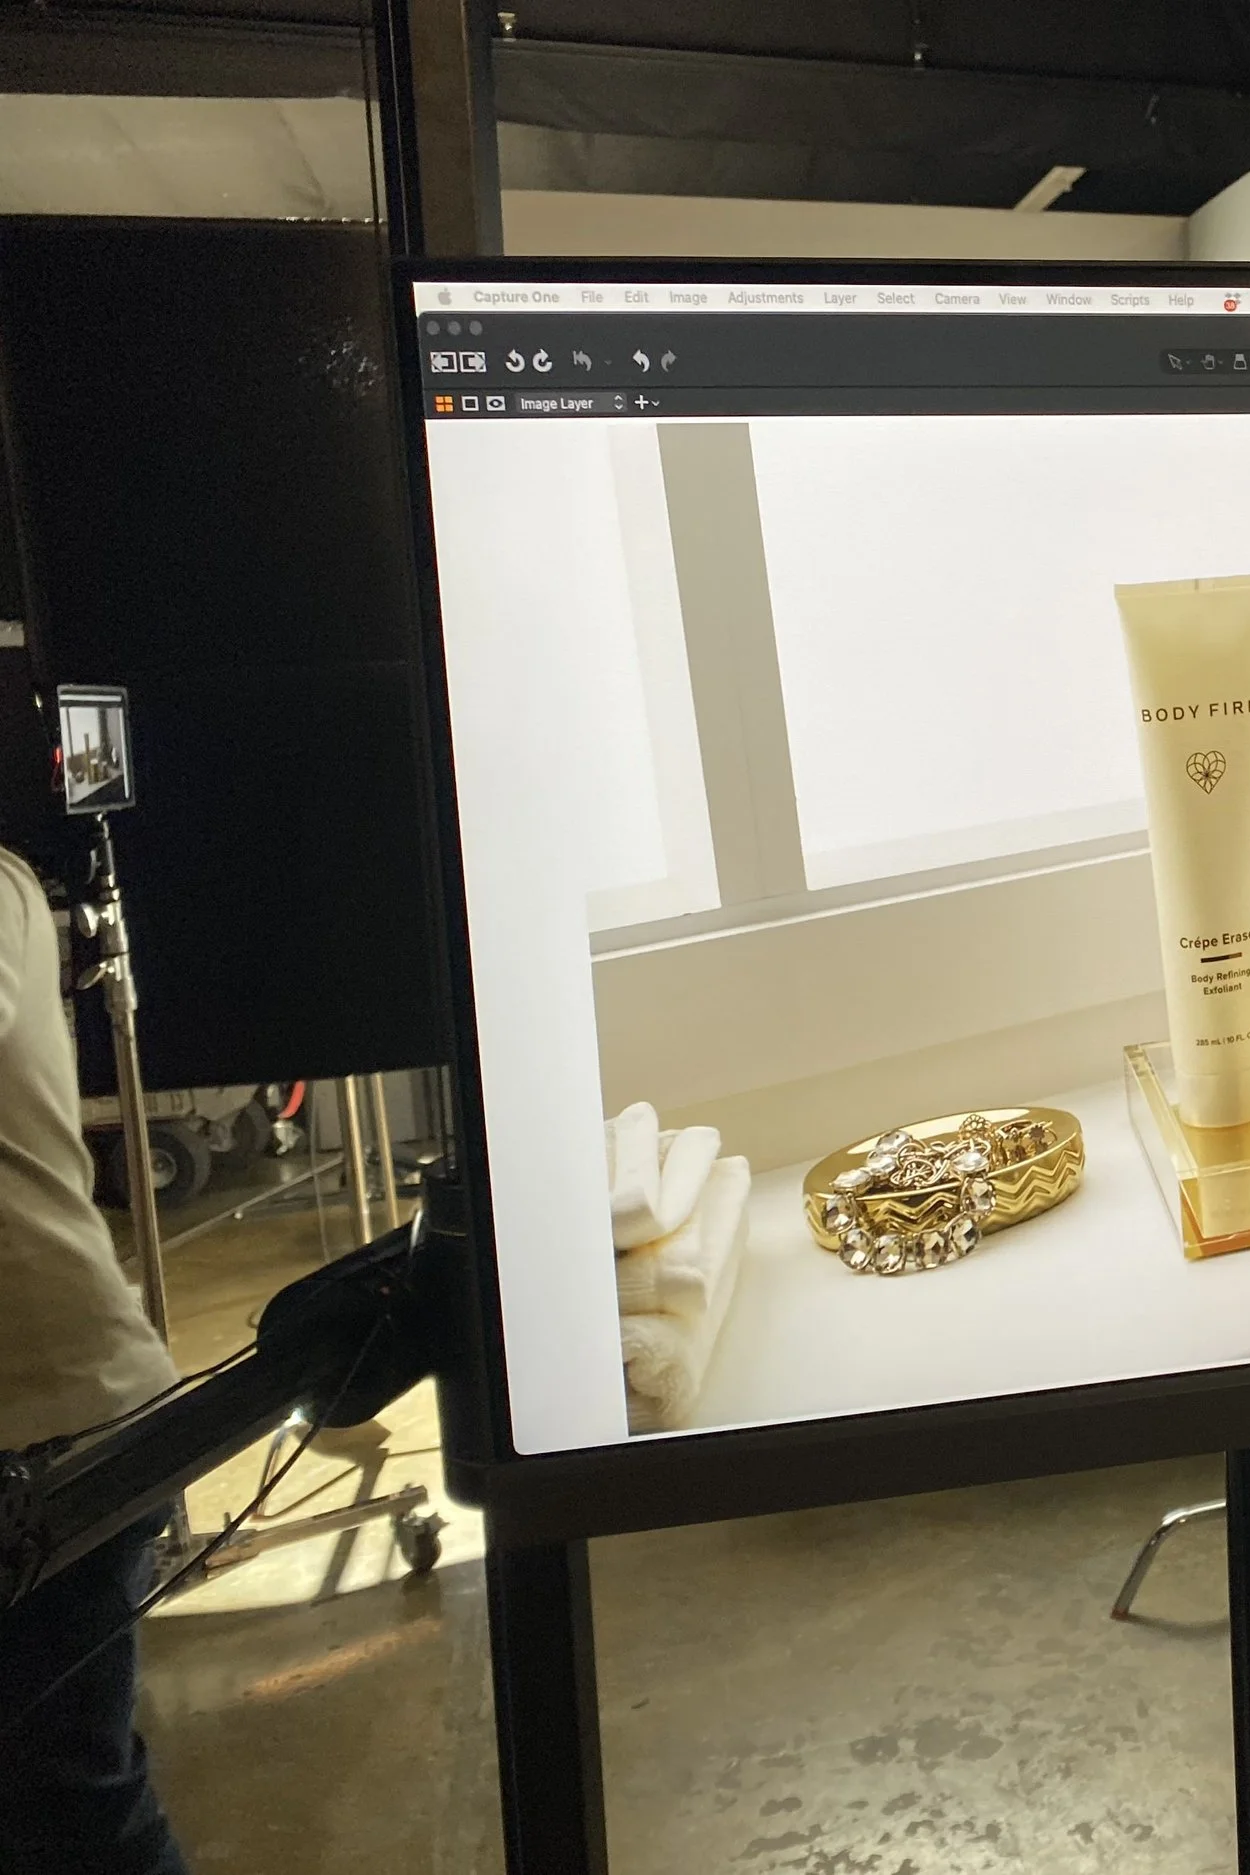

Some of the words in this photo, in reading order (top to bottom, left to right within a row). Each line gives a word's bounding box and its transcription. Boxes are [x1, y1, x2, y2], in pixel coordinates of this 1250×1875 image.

[473, 291, 528, 304] Capture
[532, 291, 560, 303] One
[581, 291, 603, 303] File
[625, 291, 649, 303] Edit
[669, 291, 708, 305] Image
[728, 291, 804, 305] Adjustments
[824, 292, 857, 306] Layer
[877, 292, 915, 304] Select
[935, 292, 980, 305] Camera
[1000, 293, 1027, 305] View
[1046, 293, 1092, 306] Window
[1110, 293, 1150, 308] Scripts
[1168, 294, 1194, 308] Help
[521, 397, 557, 412] Image
[560, 397, 593, 412] Layer
[1141, 705, 1200, 722] BODY
[1191, 974, 1214, 984] Body
[1216, 968, 1250, 981] Refining
[1203, 983, 1242, 995] Exfoliant
